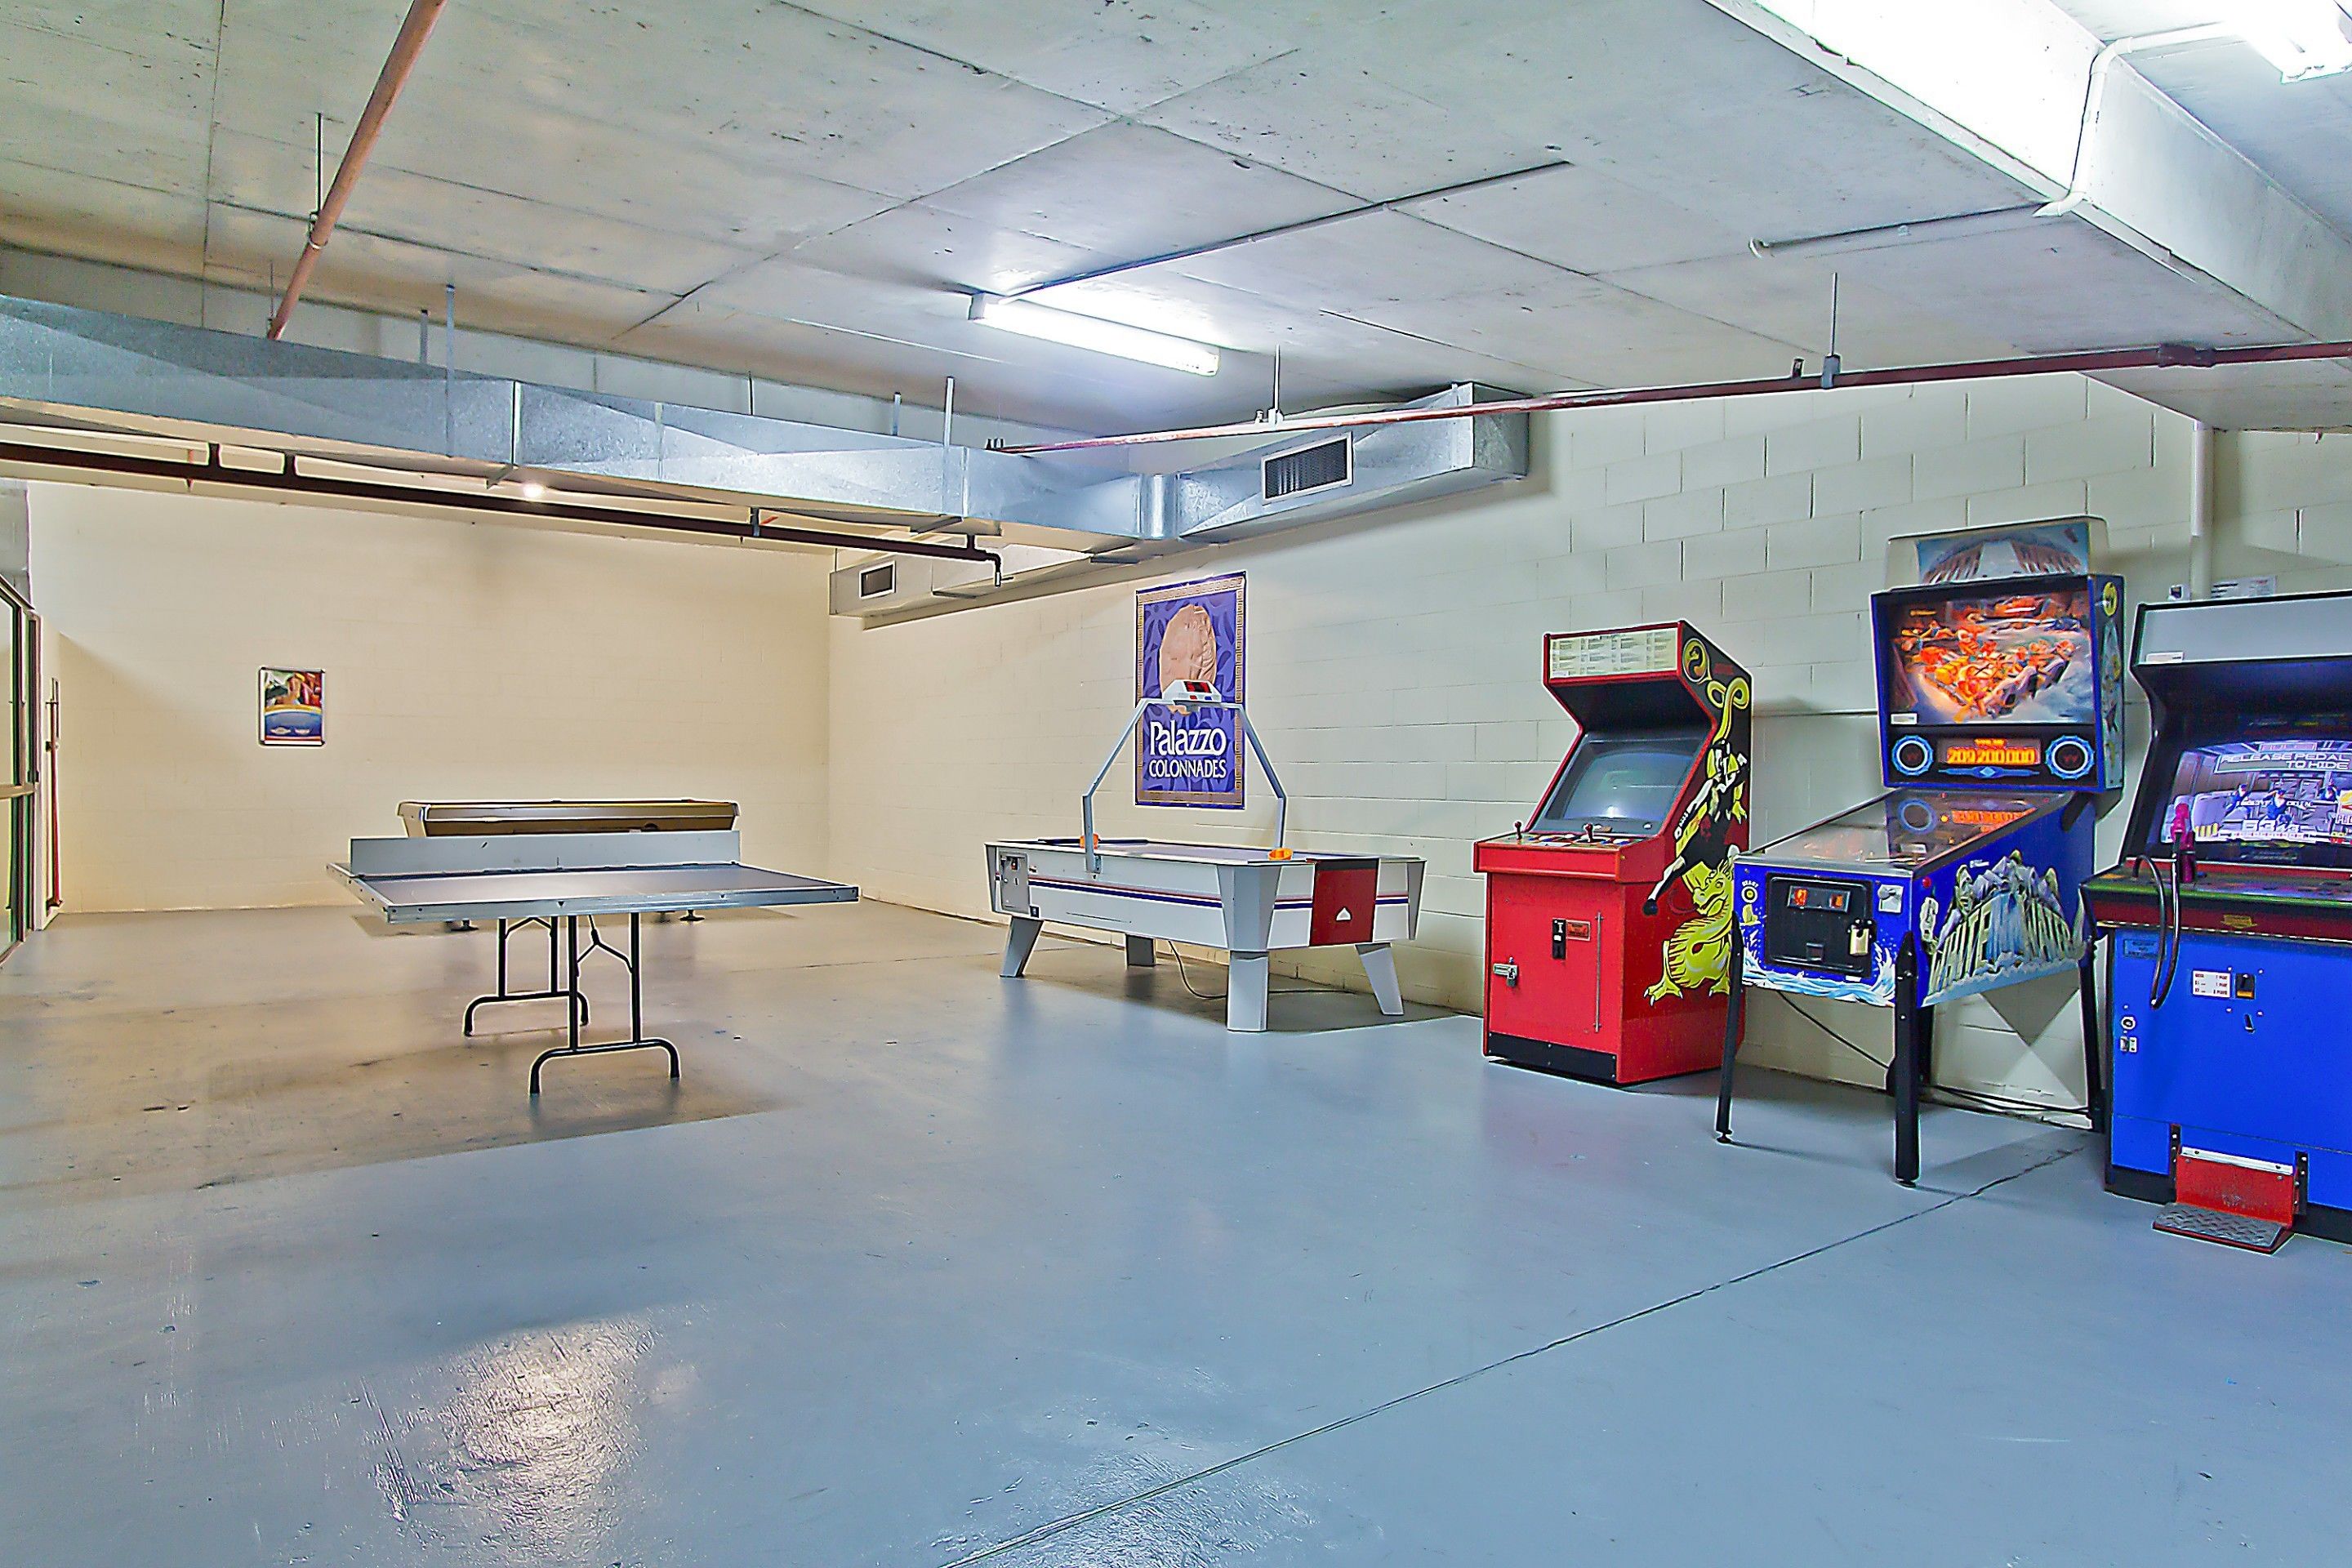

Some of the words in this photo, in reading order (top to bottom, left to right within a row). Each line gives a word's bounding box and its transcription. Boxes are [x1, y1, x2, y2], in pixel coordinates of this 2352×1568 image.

[1150, 719, 1227, 756] Palazzo
[2221, 753, 2292, 764] RELEASE
[2294, 753, 2350, 761] PEDAL
[2285, 760, 2306, 768] TO
[2309, 761, 2350, 769] HIDE
[1149, 759, 1227, 778] COLONNADES
